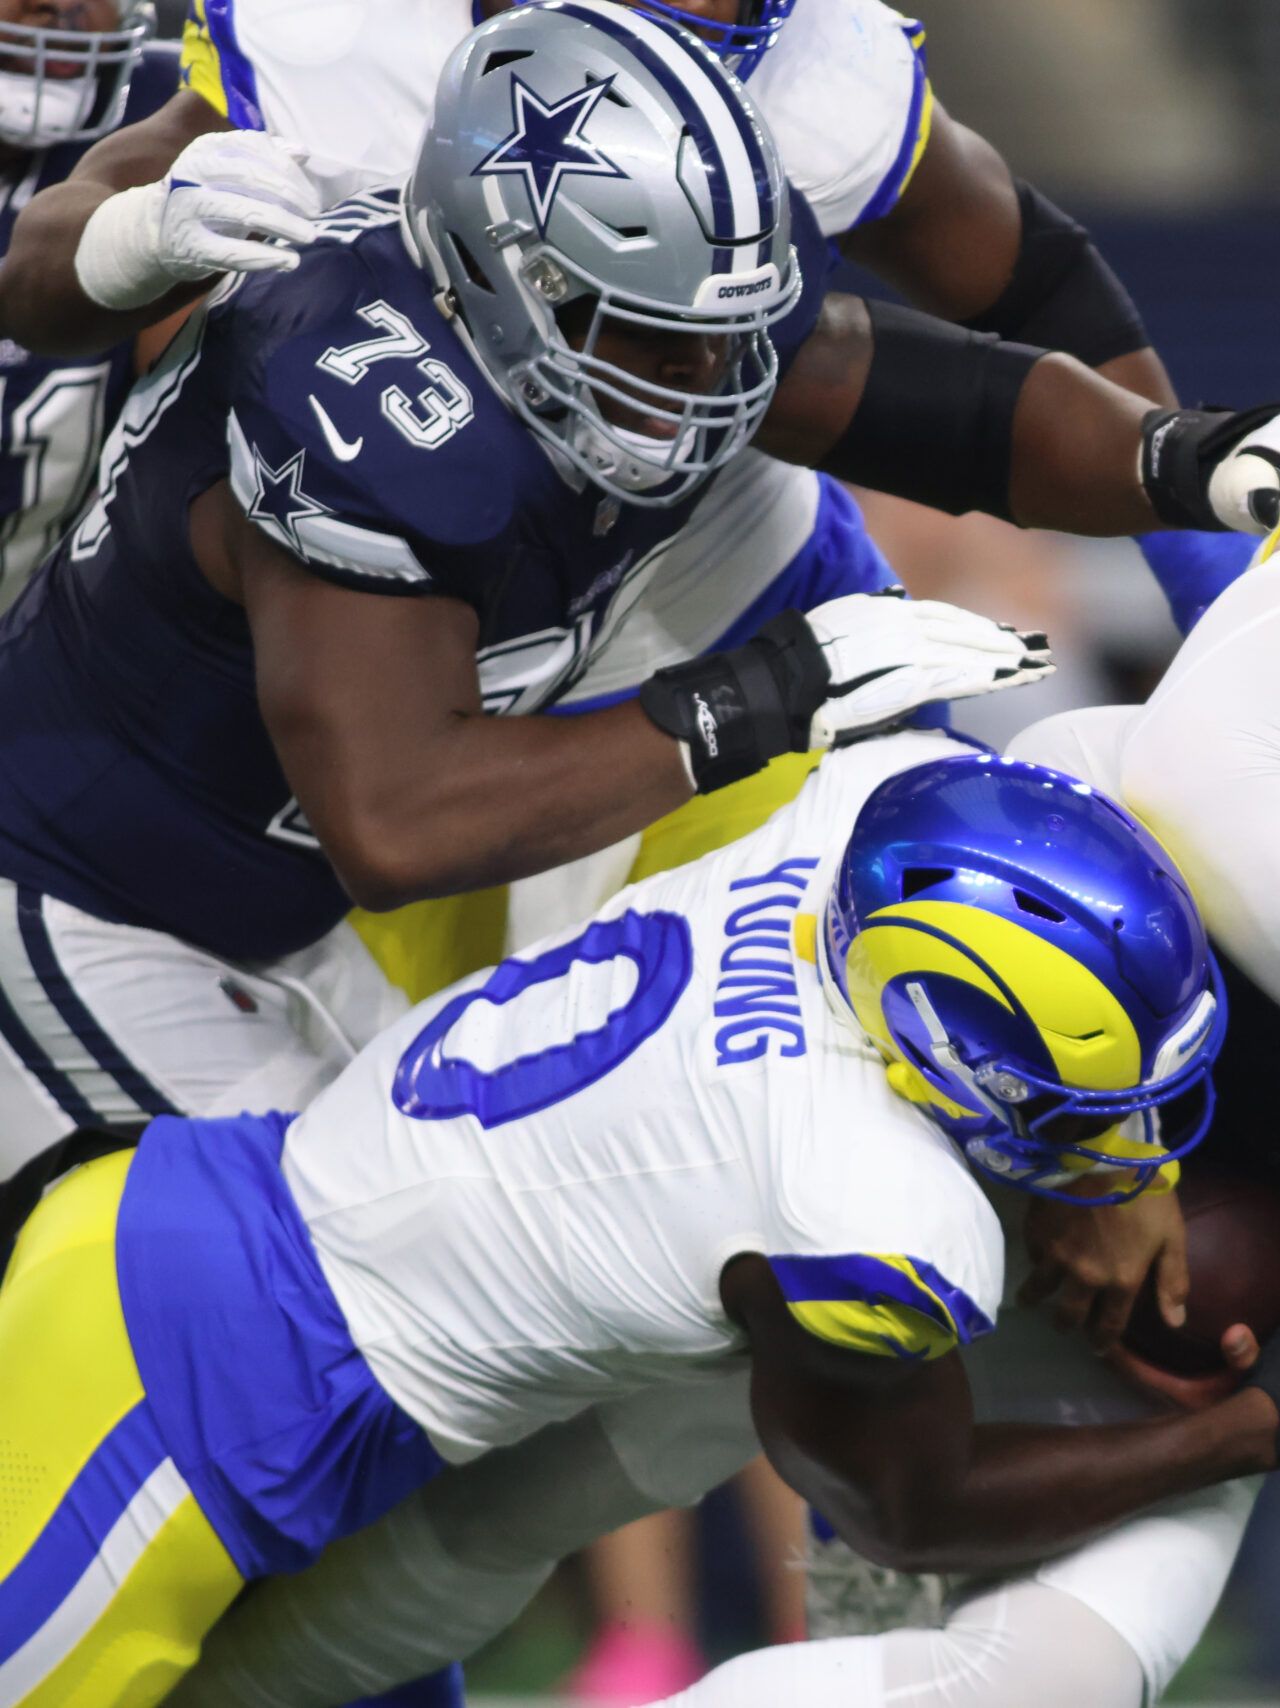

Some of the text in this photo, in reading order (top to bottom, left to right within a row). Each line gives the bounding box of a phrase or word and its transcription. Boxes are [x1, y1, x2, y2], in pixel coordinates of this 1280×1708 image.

[315, 299, 475, 450] 73
[718, 276, 772, 299] COWBOYS
[0, 361, 112, 622] 1
[391, 907, 694, 1130] 0
[713, 857, 821, 1066] YOUNG
